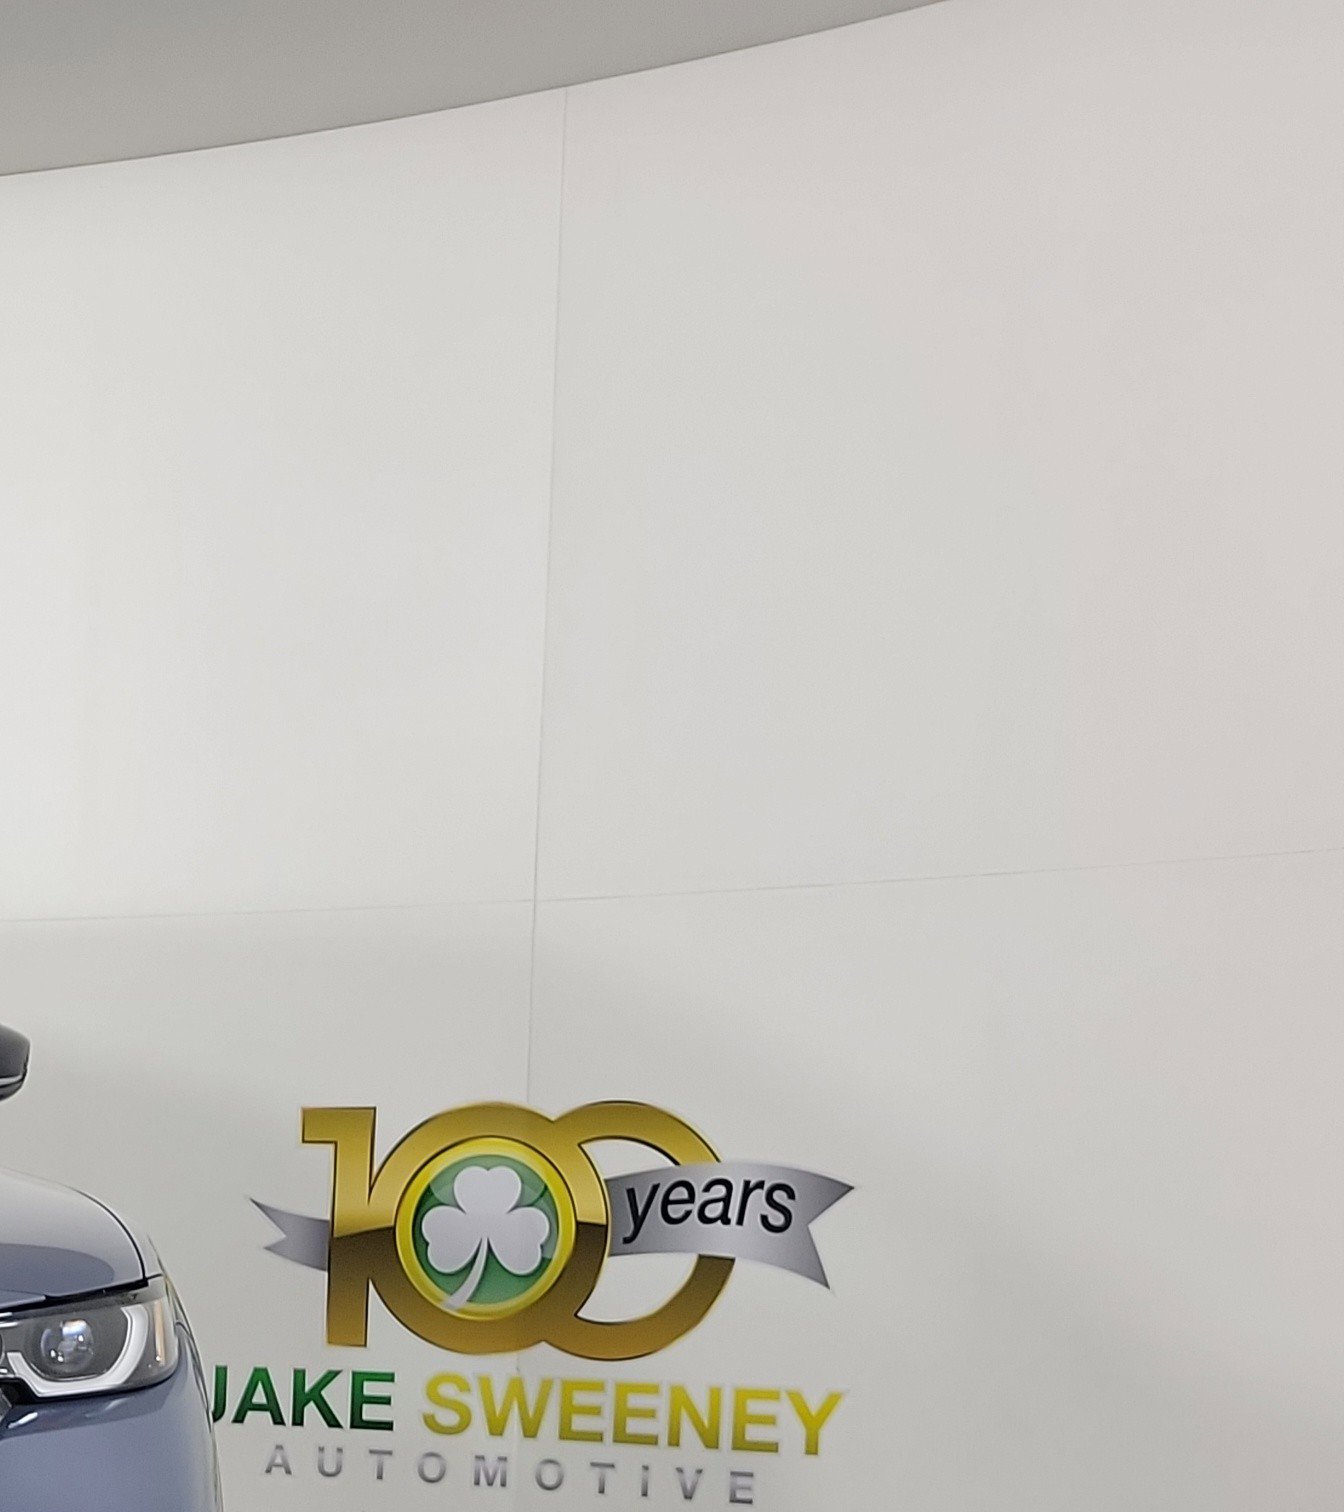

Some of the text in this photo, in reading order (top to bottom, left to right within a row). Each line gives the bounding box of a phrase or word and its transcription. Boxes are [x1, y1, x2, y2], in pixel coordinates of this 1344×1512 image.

[301, 1100, 796, 1361] 100 years
[422, 1371, 843, 1456] SWEENEY
[265, 1443, 754, 1505] AUTOMOTIVE
